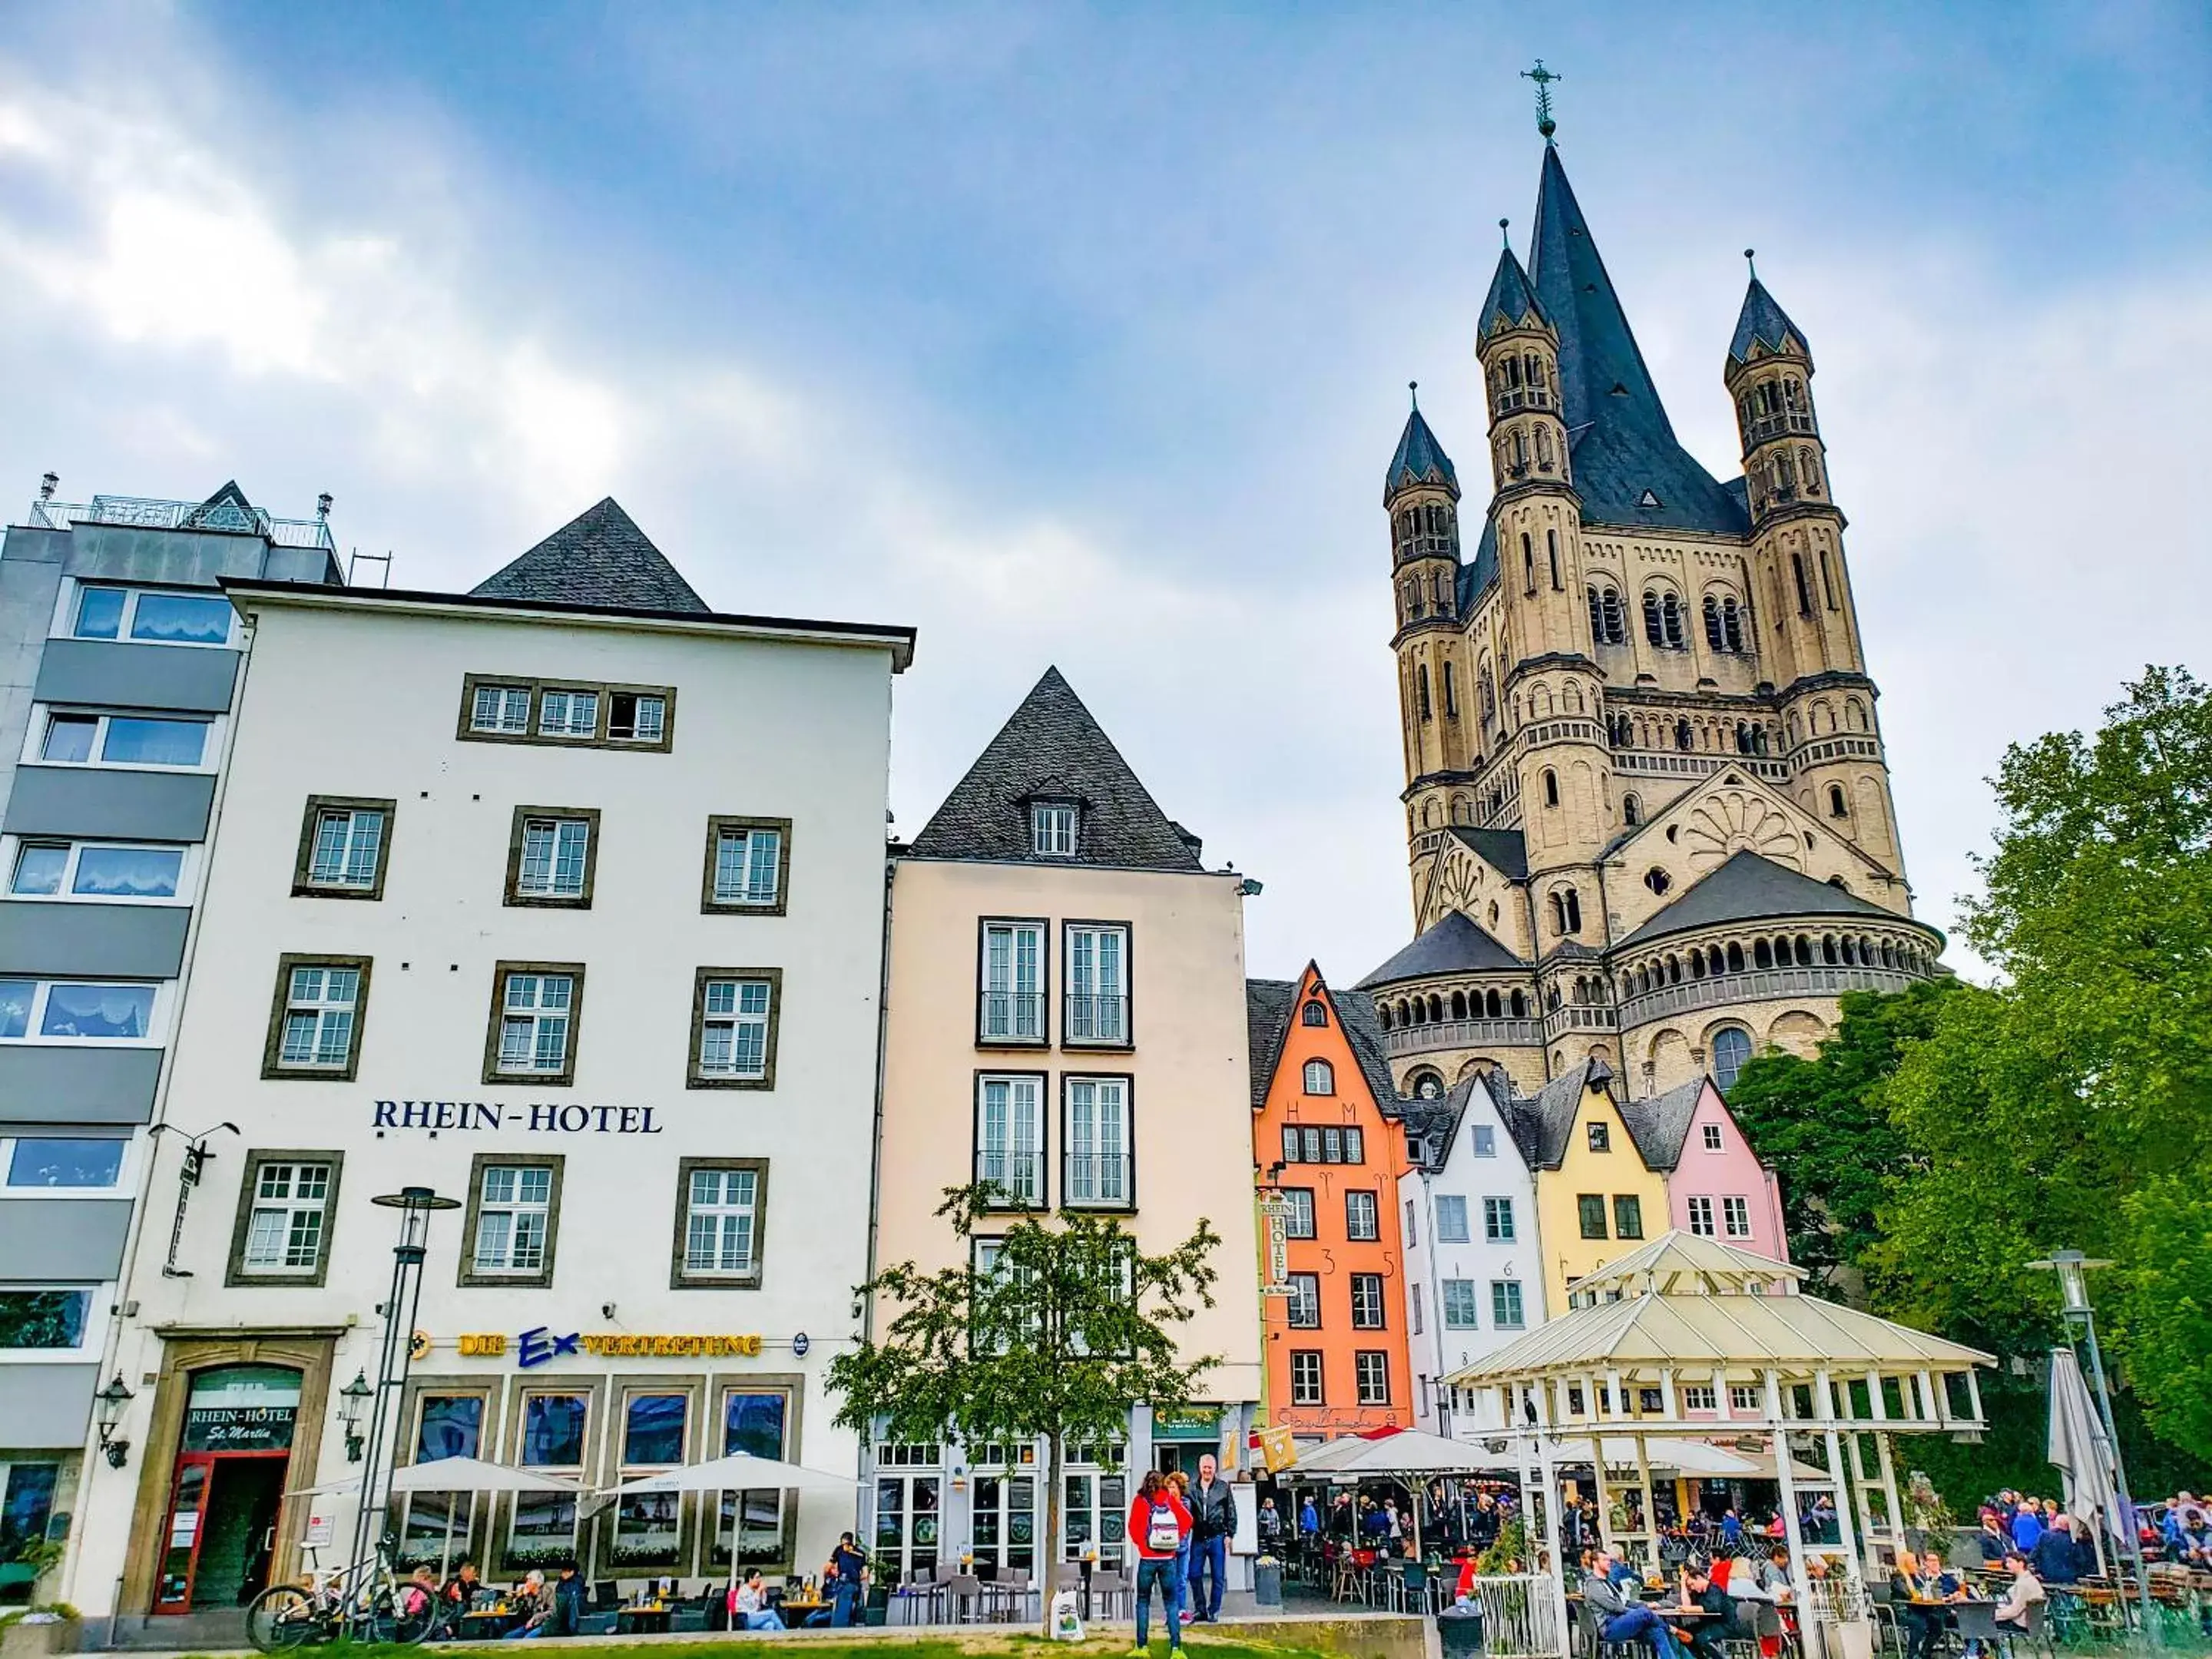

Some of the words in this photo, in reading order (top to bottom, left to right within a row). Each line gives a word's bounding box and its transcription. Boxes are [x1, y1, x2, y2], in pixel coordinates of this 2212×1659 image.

[372, 1101, 663, 1134] RHEIN-HOTEL
[1261, 1204, 1292, 1214] RHEIN
[1273, 1218, 1285, 1280] HOTEL
[459, 1334, 506, 1356] DIE
[192, 1409, 293, 1422] RHEIN-HOTEL
[229, 1426, 270, 1439] Martin
